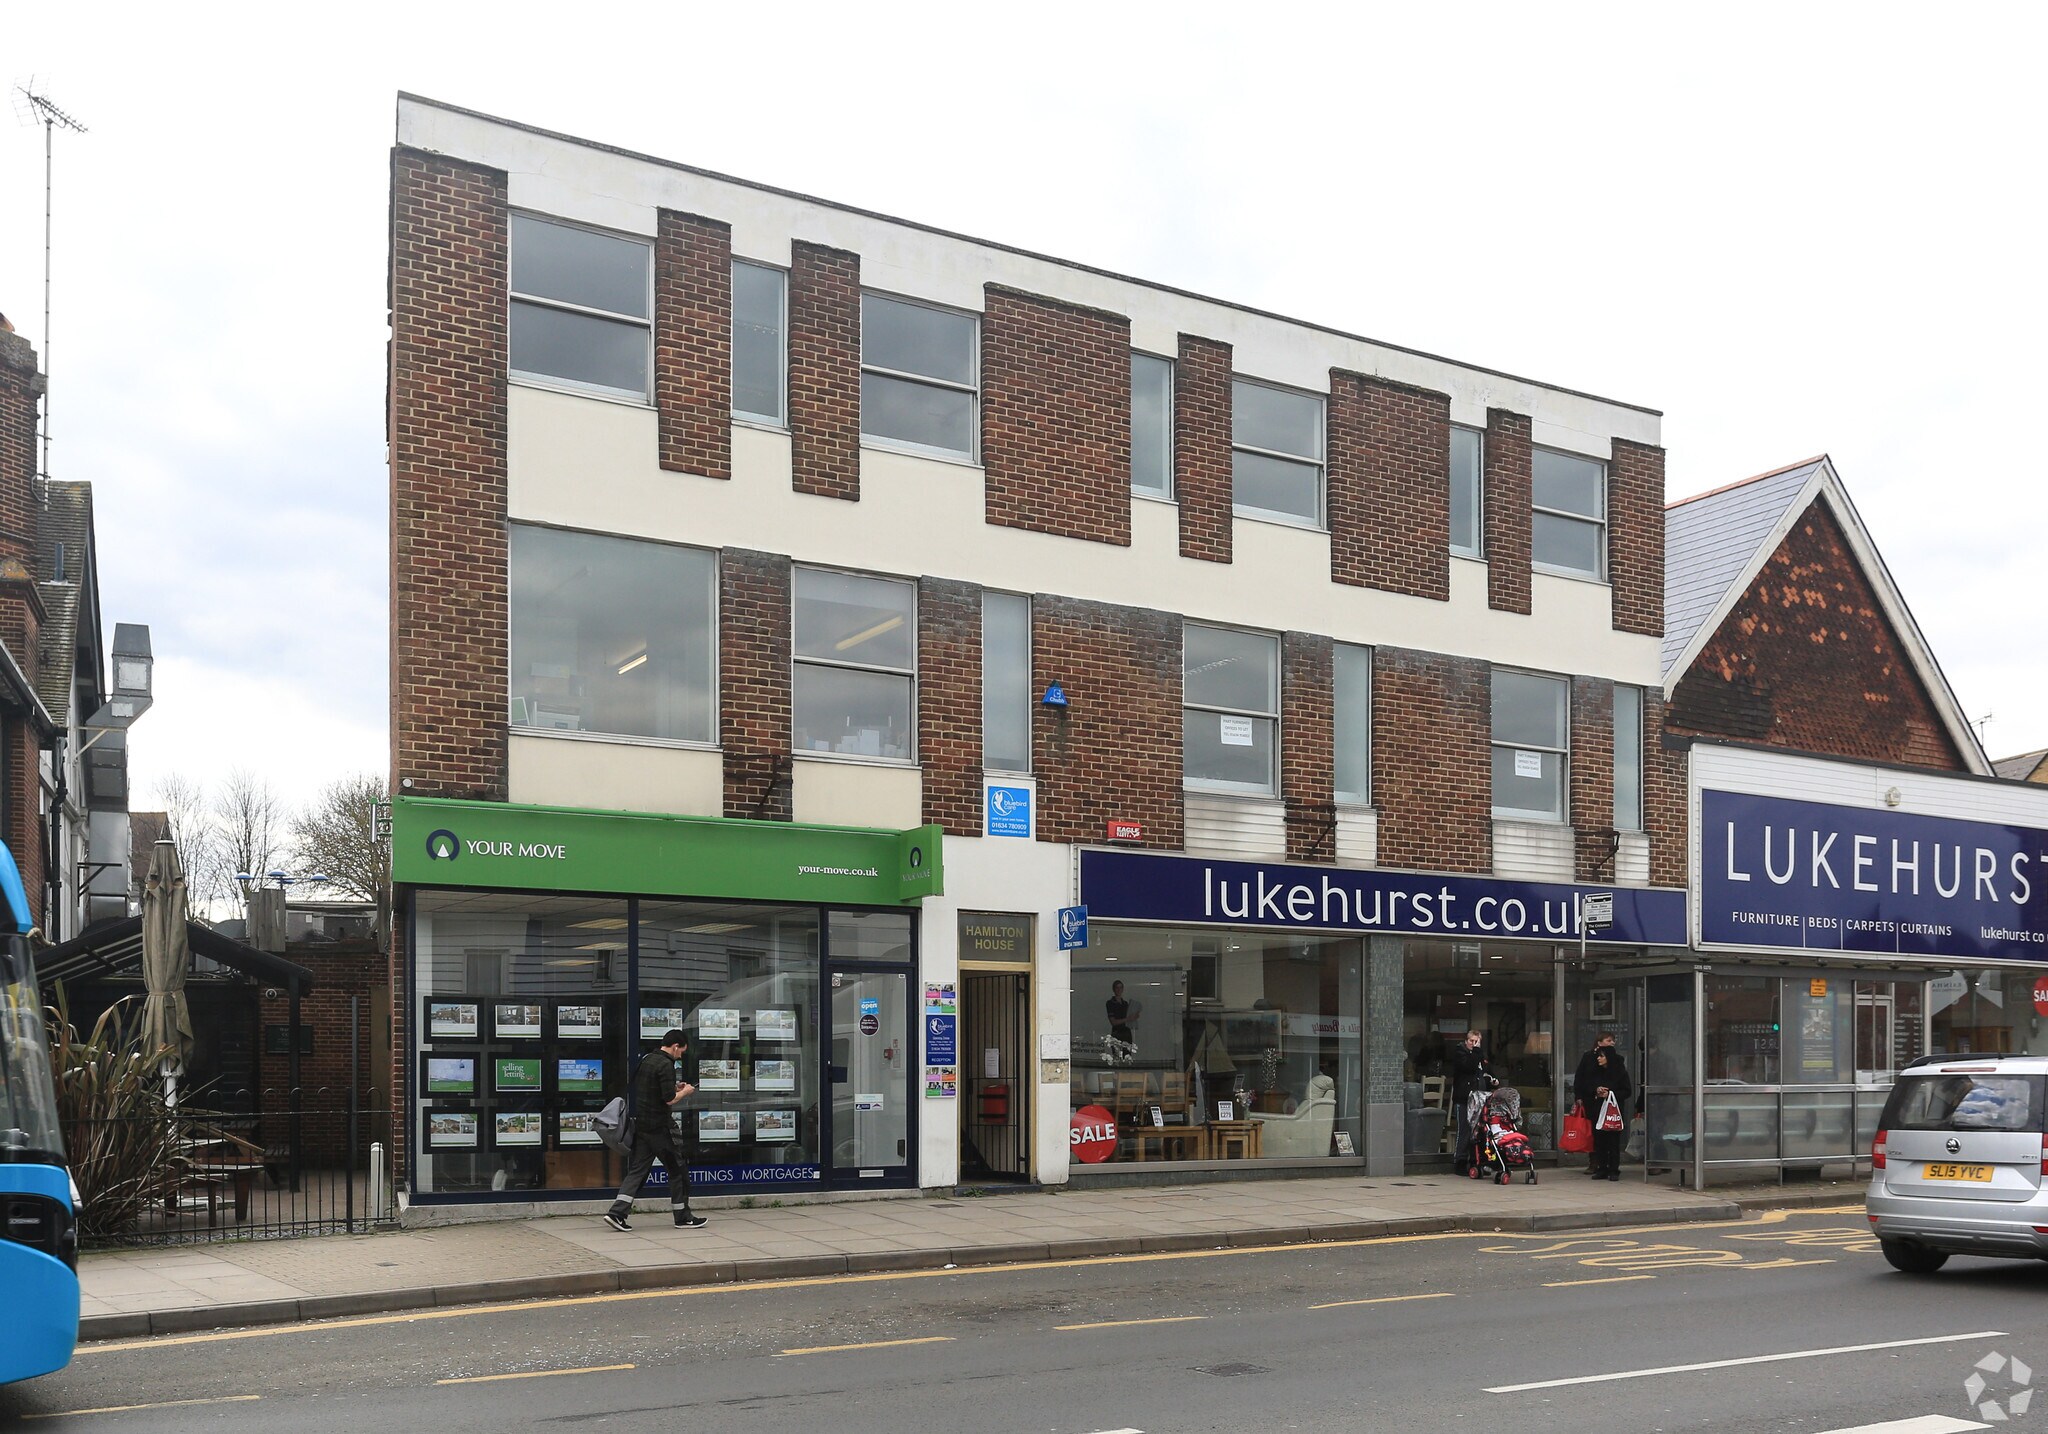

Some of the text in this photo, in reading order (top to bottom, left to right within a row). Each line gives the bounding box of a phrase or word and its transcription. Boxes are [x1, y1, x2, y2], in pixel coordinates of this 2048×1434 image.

[466, 839, 566, 860] YOUR MOVE
[1727, 821, 2048, 905] LUKEHURS
[798, 864, 878, 877] your-move.co.uk
[1732, 911, 1952, 936] FURNITURE BEDS CARPETS CURTAINS
[966, 925, 1024, 938] HAMILTON
[975, 939, 1015, 951] HOUSE
[502, 1063, 524, 1073] selling
[504, 1070, 526, 1079] letting
[1070, 1122, 1116, 1146] SALE
[688, 1169, 733, 1182] ETTINGS
[742, 1167, 814, 1181] MORTGAGES
[1930, 1165, 1985, 1179] SL15 YVC
